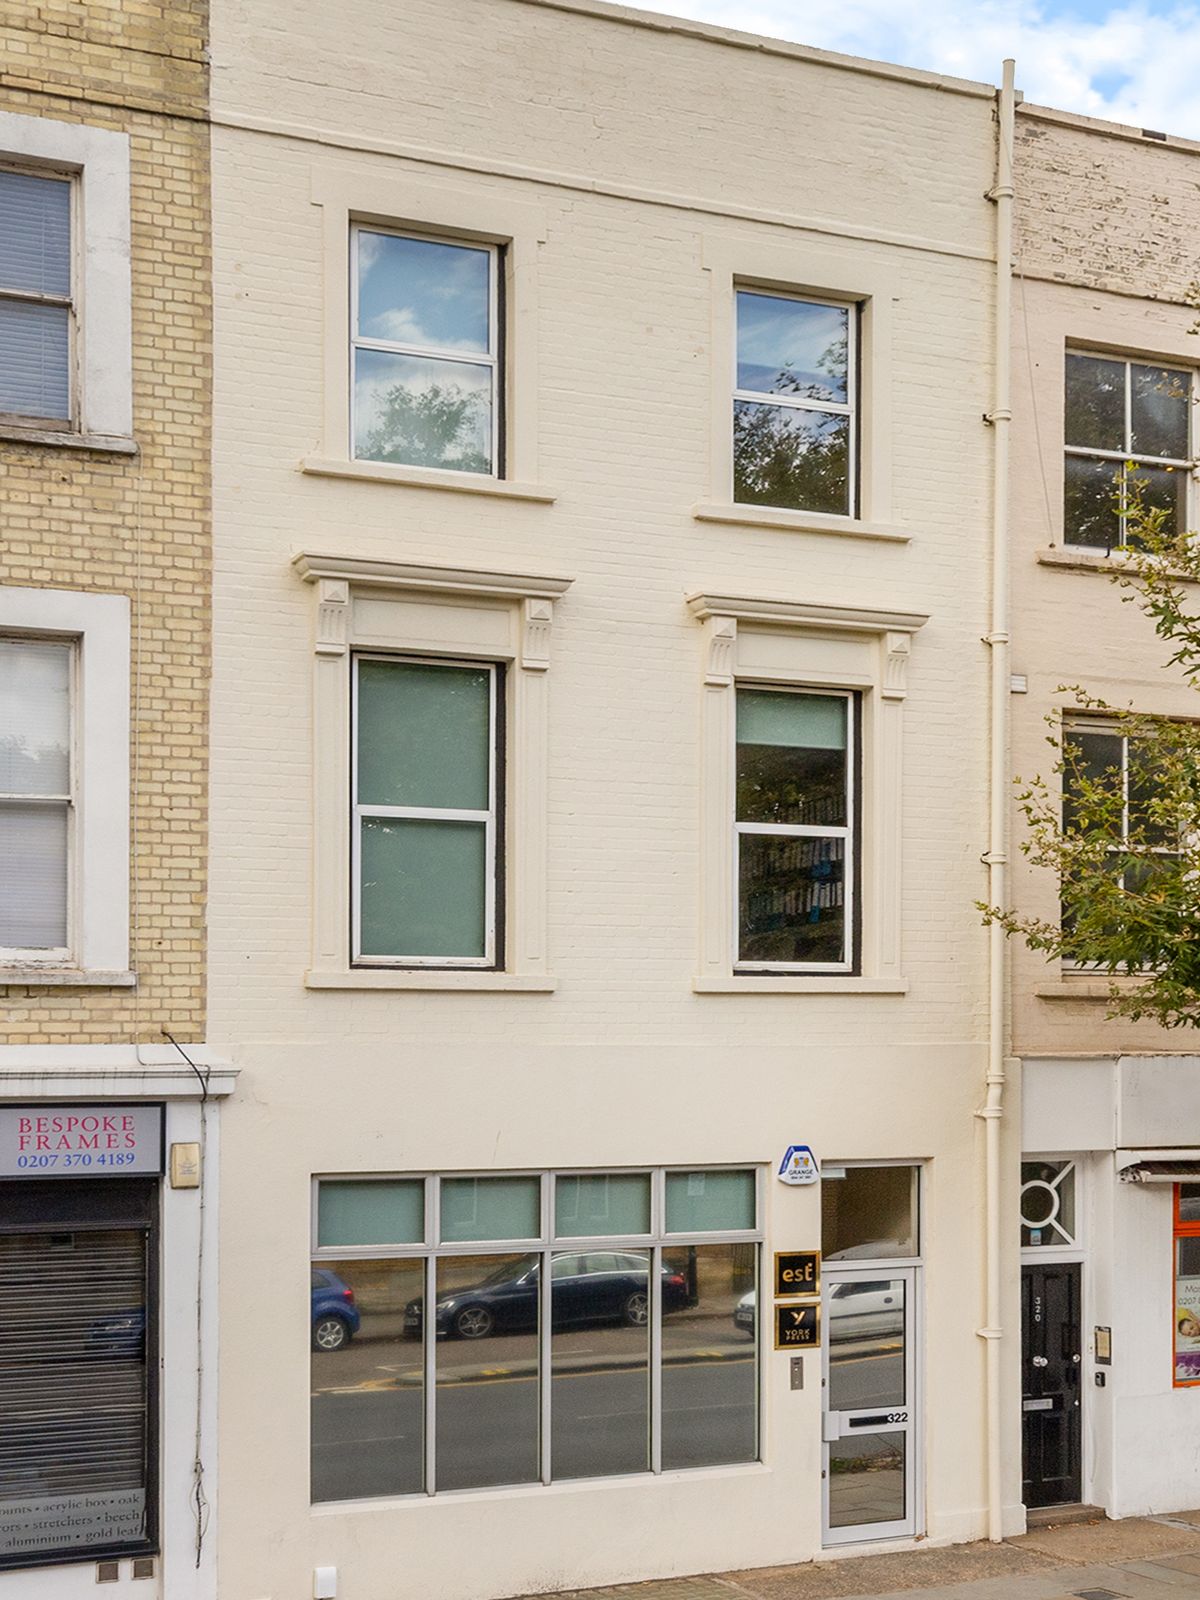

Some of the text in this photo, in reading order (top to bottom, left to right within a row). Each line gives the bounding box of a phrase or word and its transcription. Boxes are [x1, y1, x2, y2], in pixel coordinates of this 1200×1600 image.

[18, 1115, 136, 1133] BESPOKE
[18, 1133, 136, 1151] FRAMES
[17, 1152, 136, 1168] 0207 370 4189
[782, 1262, 813, 1282] est
[887, 1411, 908, 1424] 322
[43, 1500, 82, 1513] acrylic
[85, 1498, 107, 1507] box
[117, 1494, 140, 1504] oak
[32, 1515, 93, 1530] stretchers
[104, 1510, 140, 1523] beech
[5, 1525, 139, 1548] aluminium gold leaf
